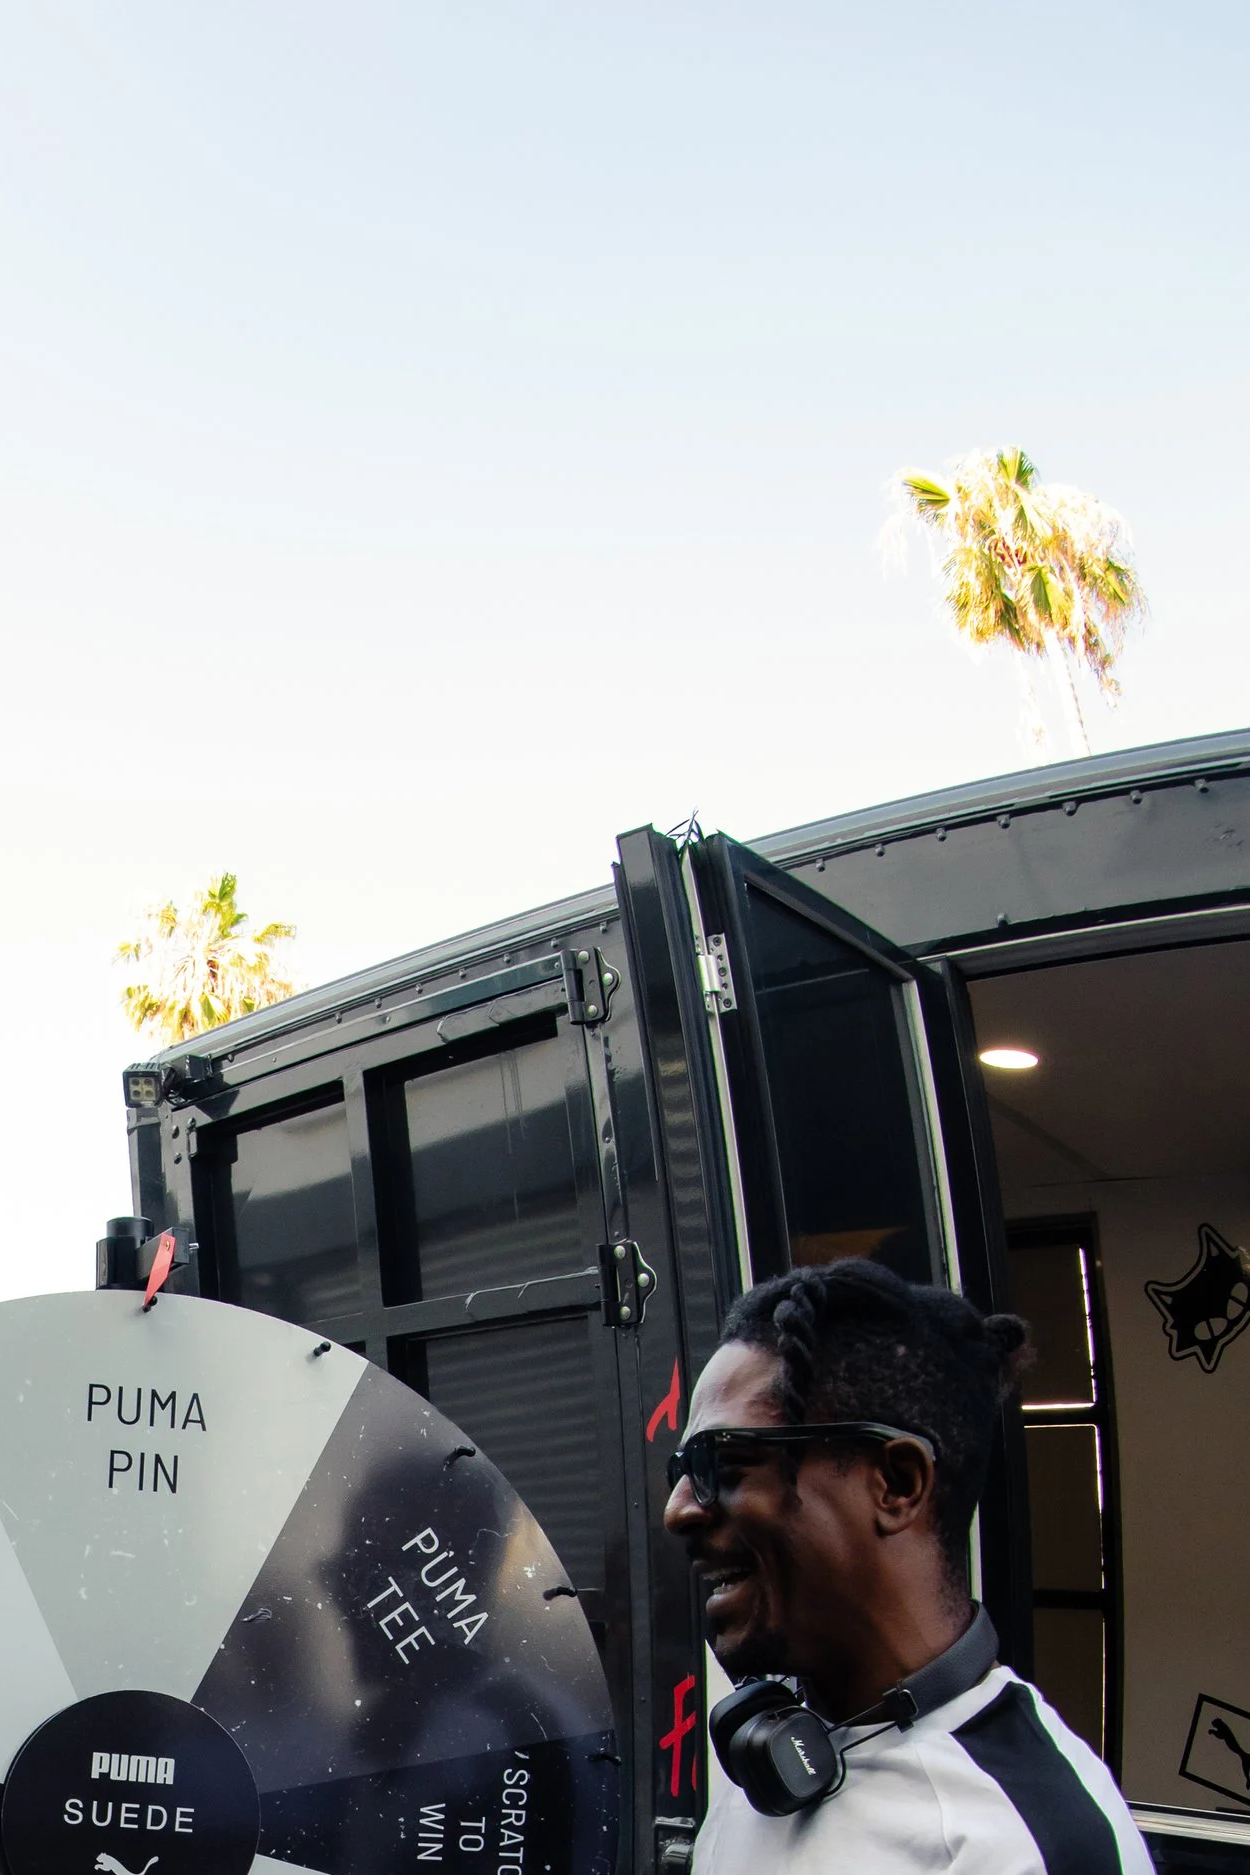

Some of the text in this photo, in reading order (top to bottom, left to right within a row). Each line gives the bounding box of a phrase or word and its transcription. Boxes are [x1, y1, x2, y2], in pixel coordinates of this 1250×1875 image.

[87, 1383, 207, 1432] PUMA
[108, 1449, 179, 1494] PIN
[401, 1527, 489, 1646] PUMA
[366, 1576, 436, 1664] TEE
[90, 1751, 176, 1785] PUMA
[790, 1736, 817, 1776] Marshall
[63, 1798, 195, 1833] SUEDE
[416, 1803, 446, 1861] WIN
[458, 1816, 486, 1852] TO
